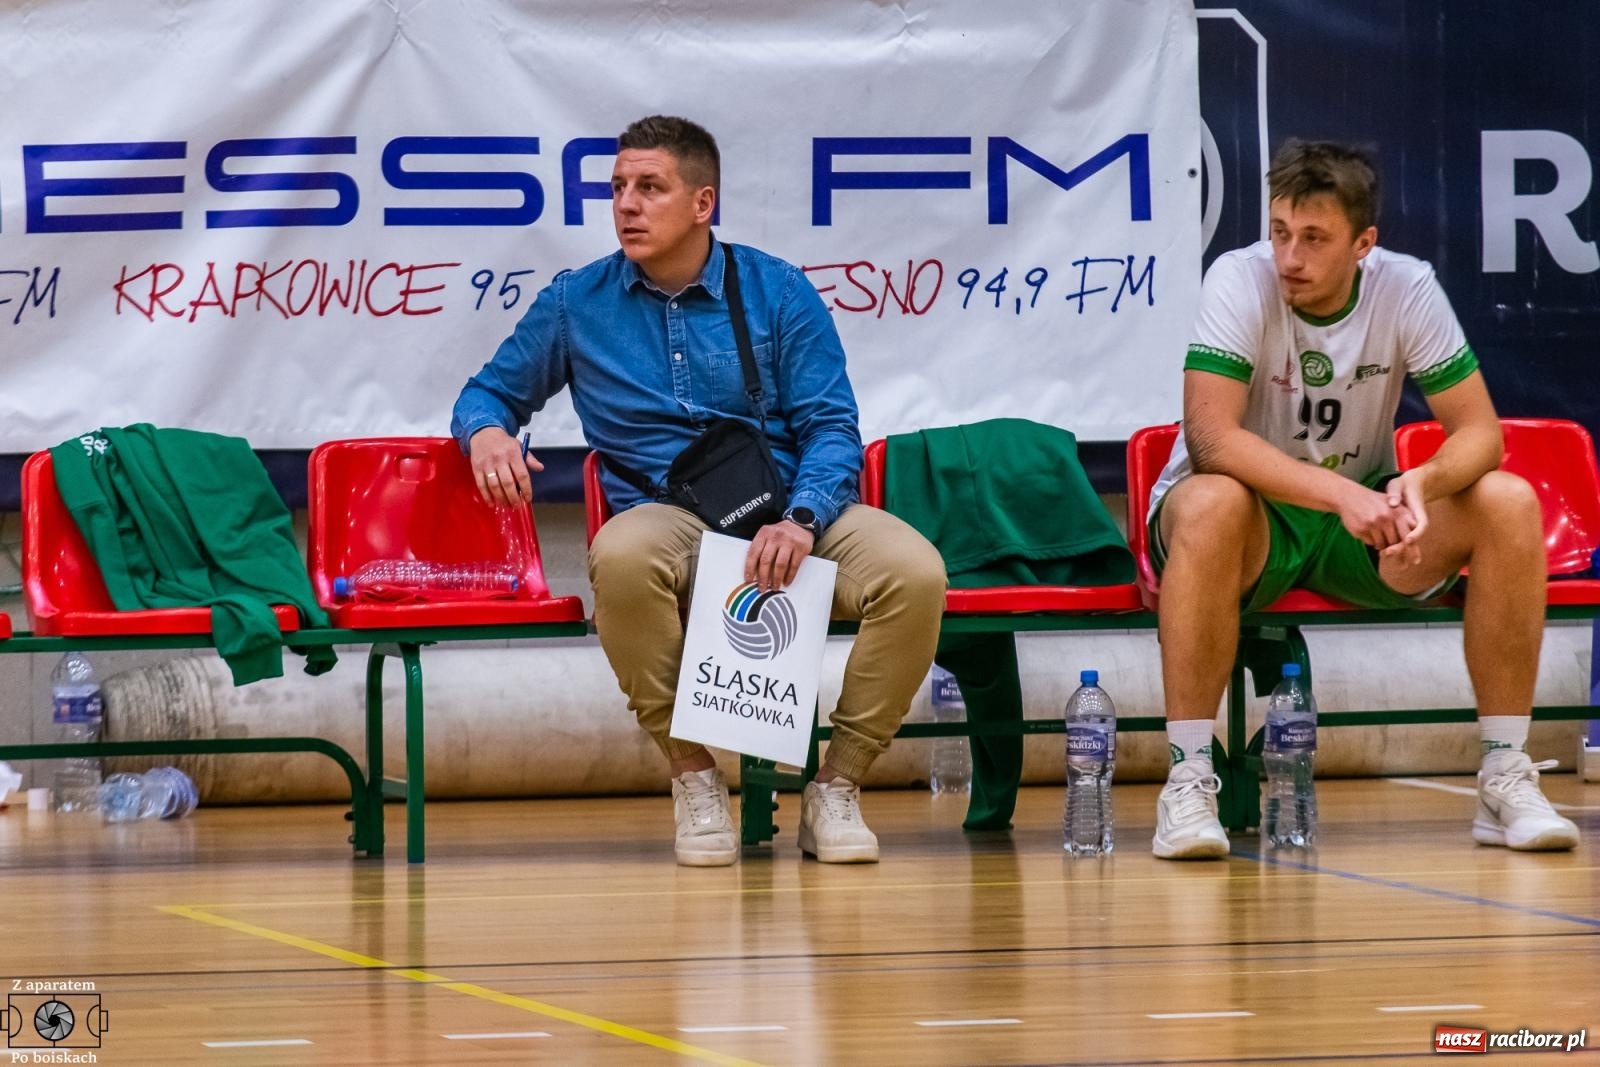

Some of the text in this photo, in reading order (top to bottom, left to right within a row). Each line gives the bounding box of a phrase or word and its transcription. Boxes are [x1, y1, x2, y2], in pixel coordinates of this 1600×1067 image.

[813, 133, 1151, 226] FM
[1481, 130, 1600, 274] R
[113, 259, 462, 323] KRAPKOWICE
[471, 269, 572, 310] 95
[957, 267, 1048, 315] 94,9
[1066, 255, 1155, 314] FM
[691, 691, 795, 729] SIATKÓWKA
[696, 656, 798, 706] ŚLĄSKA
